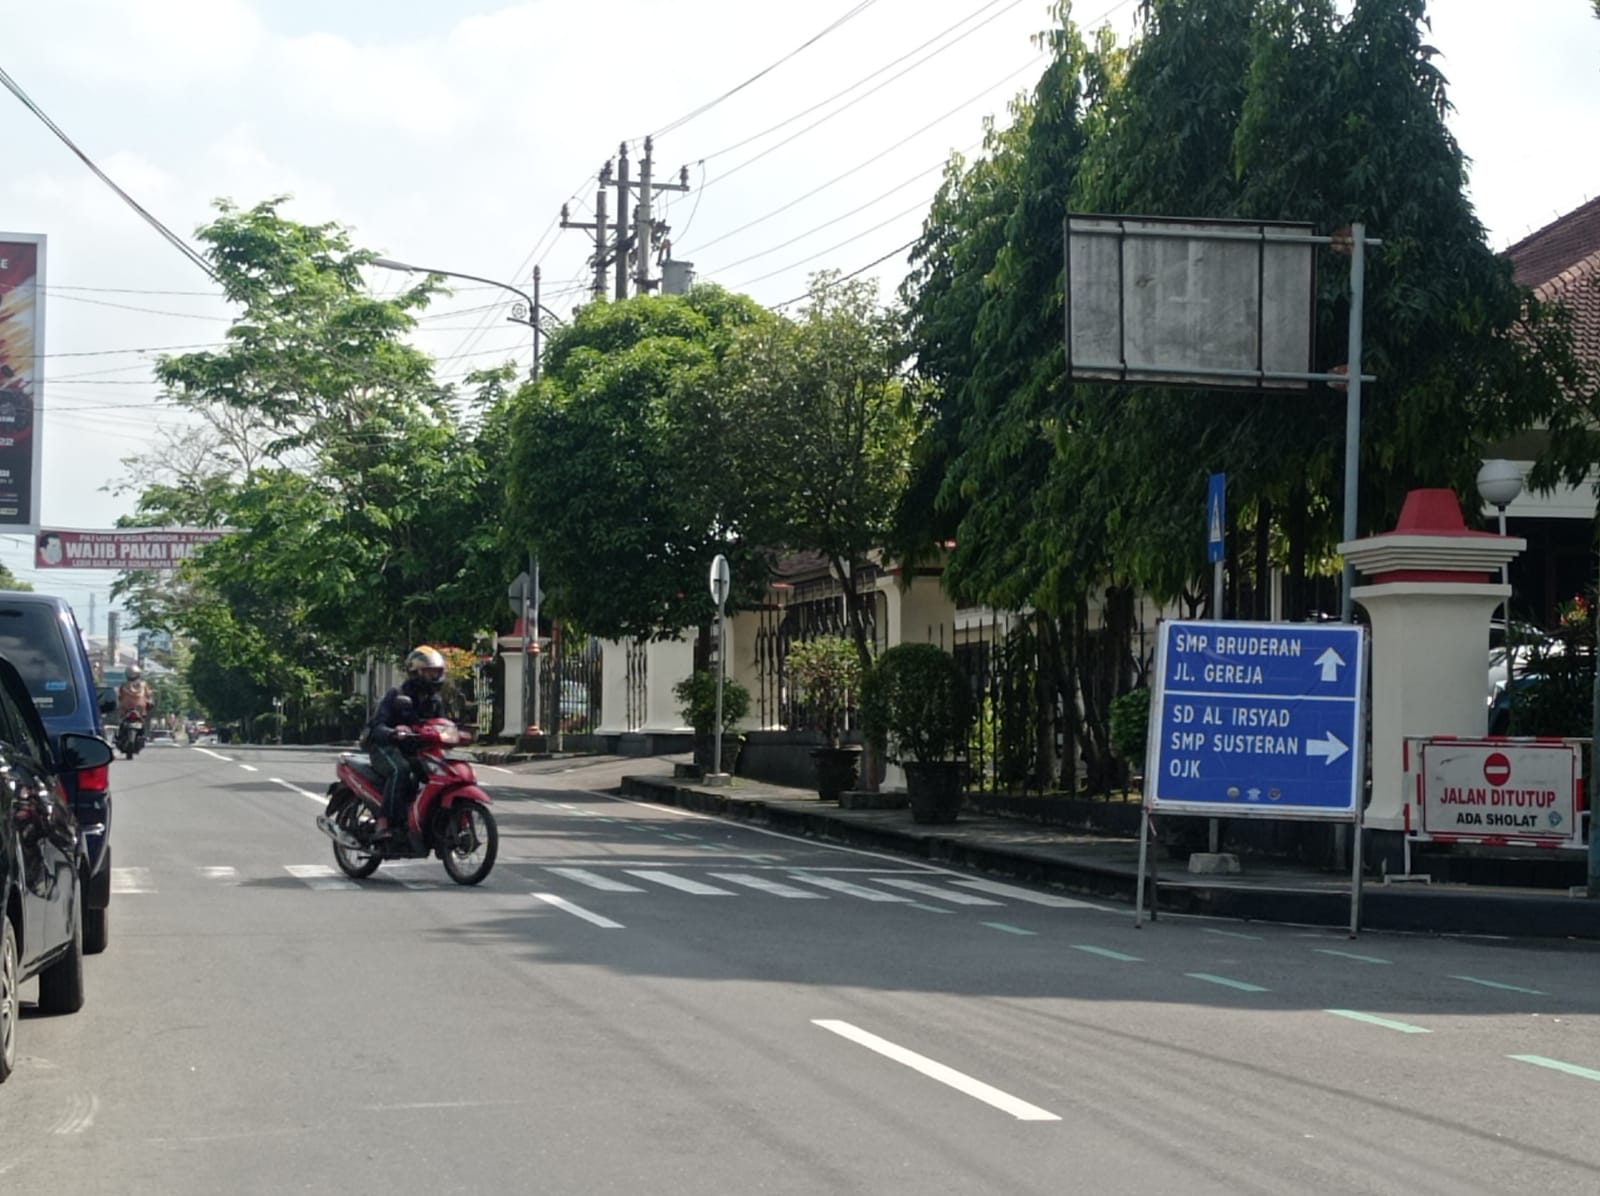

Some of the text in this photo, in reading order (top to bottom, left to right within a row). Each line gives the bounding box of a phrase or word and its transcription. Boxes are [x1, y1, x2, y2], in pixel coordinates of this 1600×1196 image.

[66, 542, 116, 559] WAJIB
[121, 543, 167, 559] PAKAI
[1176, 634, 1301, 656] SMP BRUDERAN
[1173, 663, 1263, 684] JL. GEREJA
[1173, 705, 1290, 727] SD AL IRSYAD
[1171, 733, 1299, 755] SMP SUSTERAN
[1170, 759, 1200, 778] OJK
[1440, 787, 1556, 808] JALAN DITUTUP
[1456, 812, 1538, 827] ADA SHOLAT
